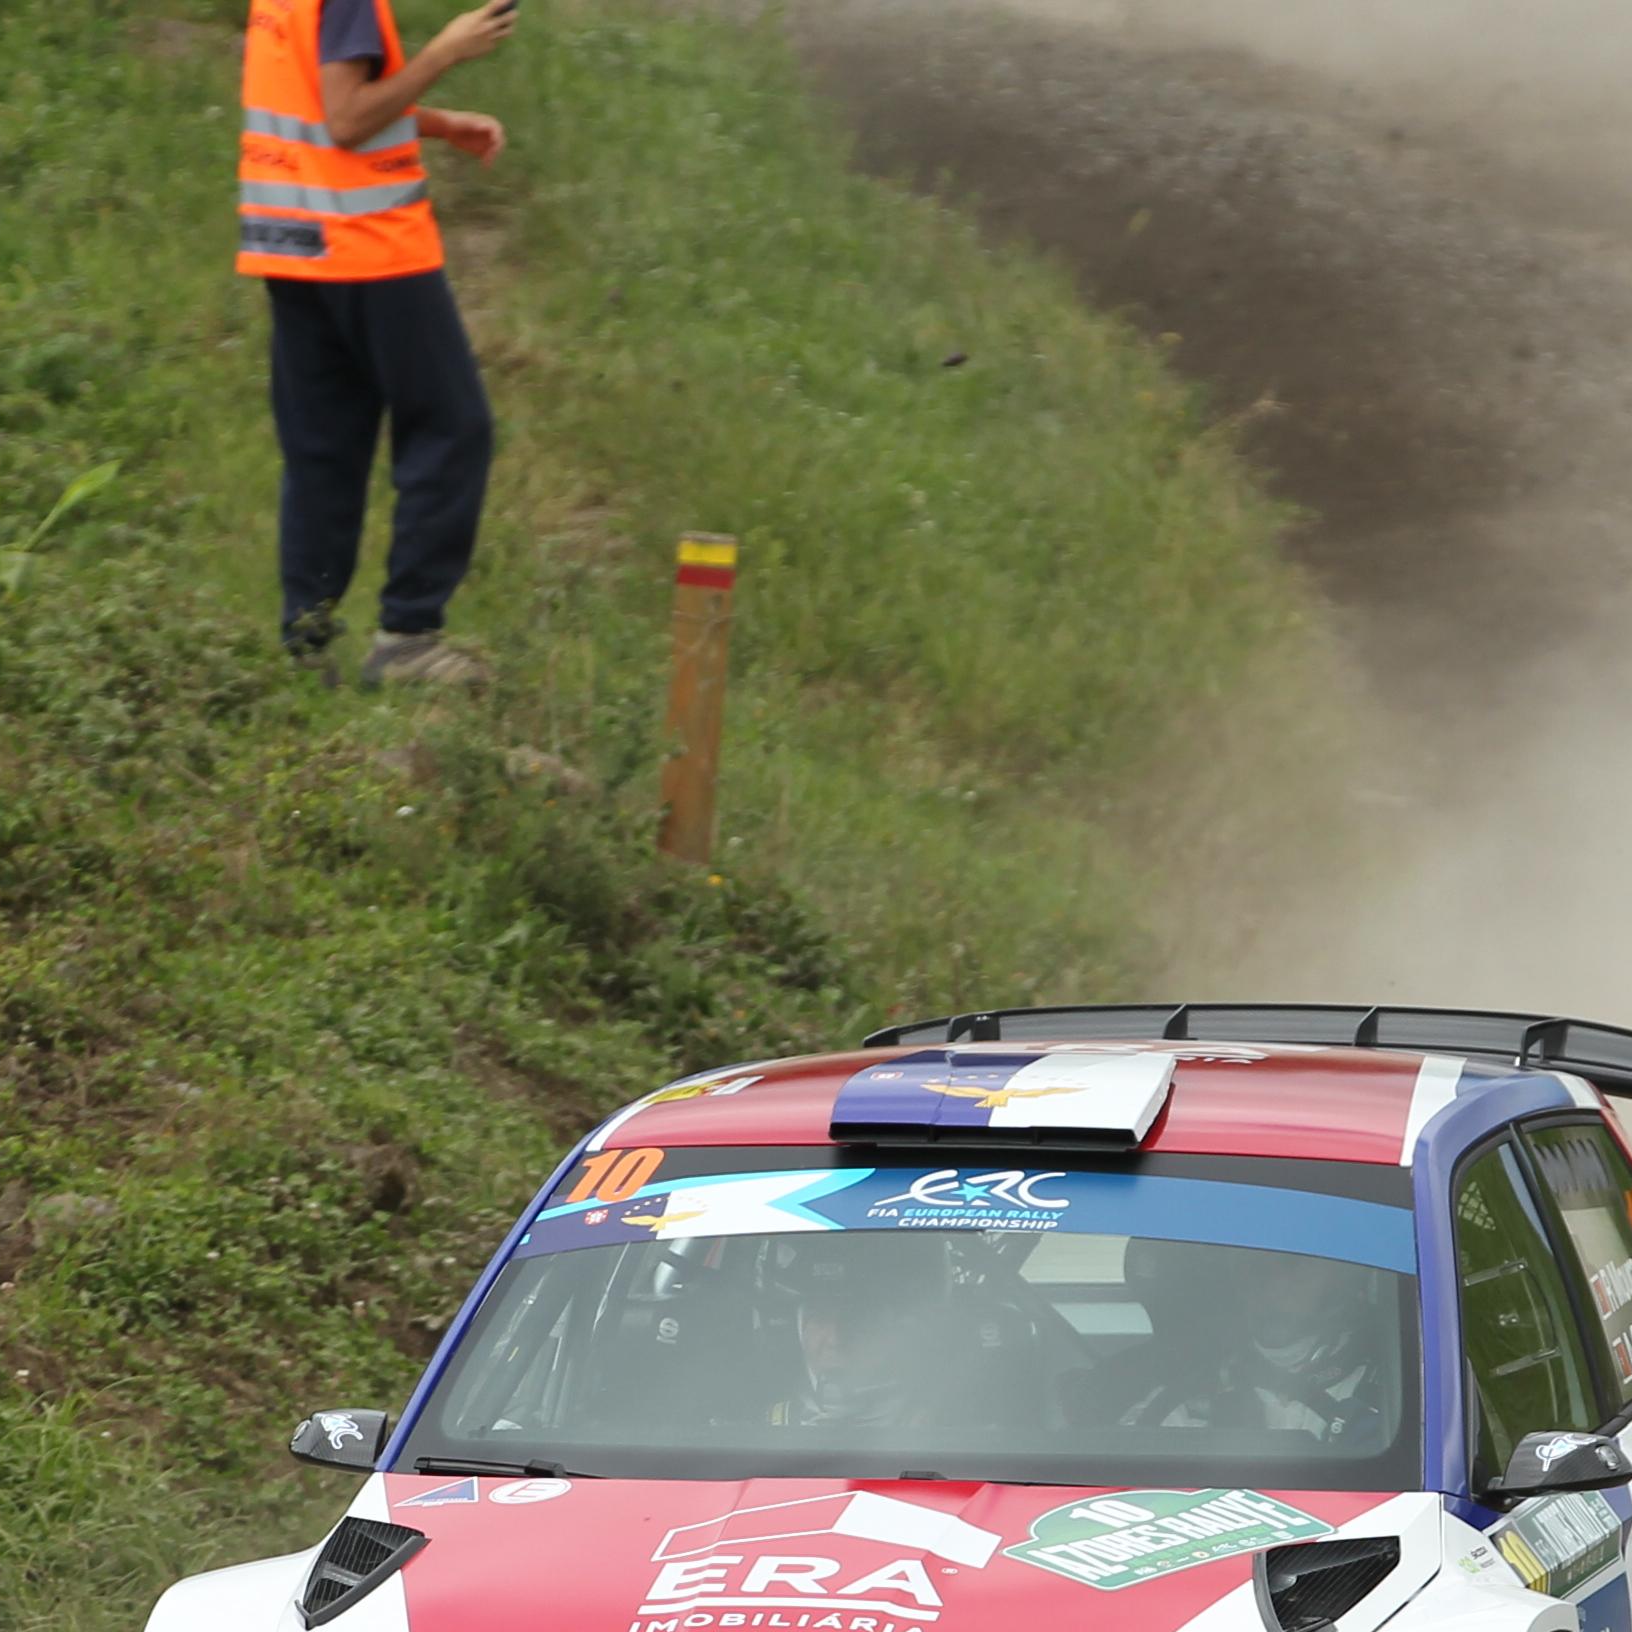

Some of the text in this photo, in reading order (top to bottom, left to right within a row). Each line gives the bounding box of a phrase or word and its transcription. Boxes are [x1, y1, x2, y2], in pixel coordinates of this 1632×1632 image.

[564, 1147, 665, 1202] 10
[874, 1169, 1070, 1208] ERC
[867, 1207, 1064, 1220] FIA EUROPEAN RALLY
[898, 1217, 1058, 1230] CHAMPIONSHIP
[1069, 1499, 1156, 1529] 10
[1026, 1522, 1166, 1581] AZORES
[1155, 1490, 1312, 1541] RALLYE
[645, 1555, 944, 1607] ERA
